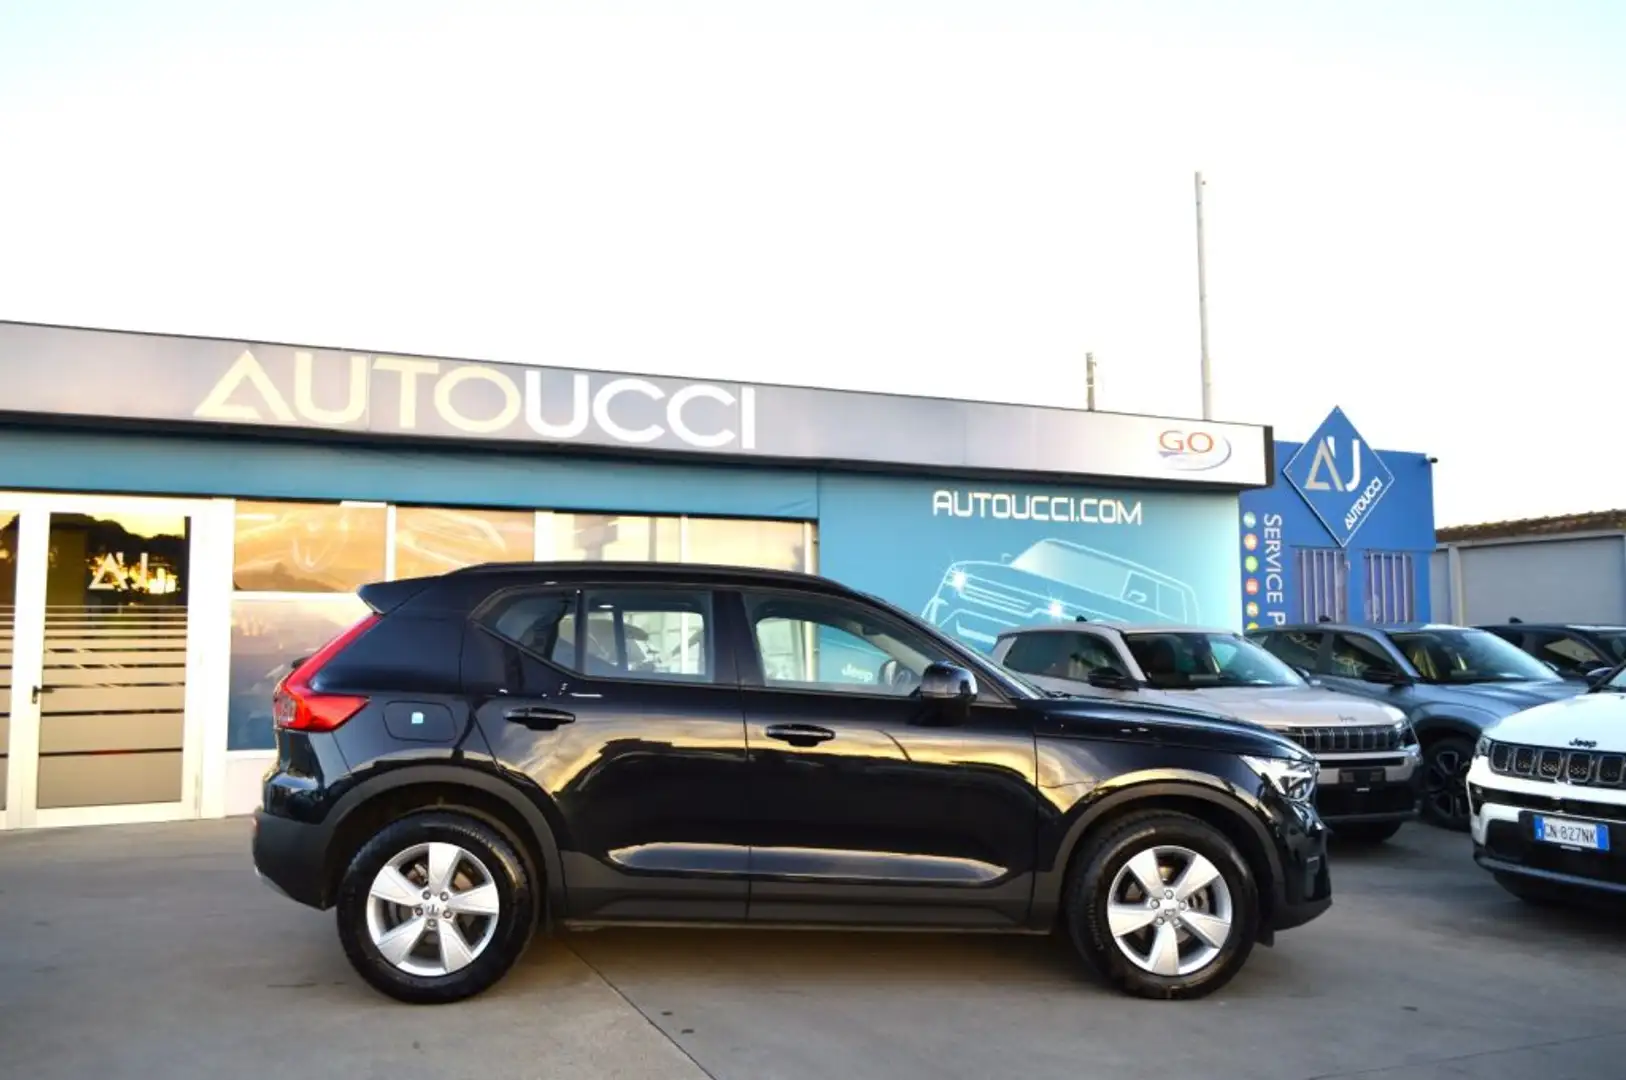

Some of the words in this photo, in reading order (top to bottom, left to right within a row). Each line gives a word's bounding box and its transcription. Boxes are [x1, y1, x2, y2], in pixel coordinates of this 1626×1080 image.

[193, 350, 757, 450] AUTOUCCI
[1159, 429, 1214, 453] GO
[932, 489, 1142, 526] AUTOUCCI.COM
[1343, 475, 1383, 531] AUTOUCCI
[1263, 512, 1284, 604] SERVICE
[1569, 737, 1598, 749] Jeep
